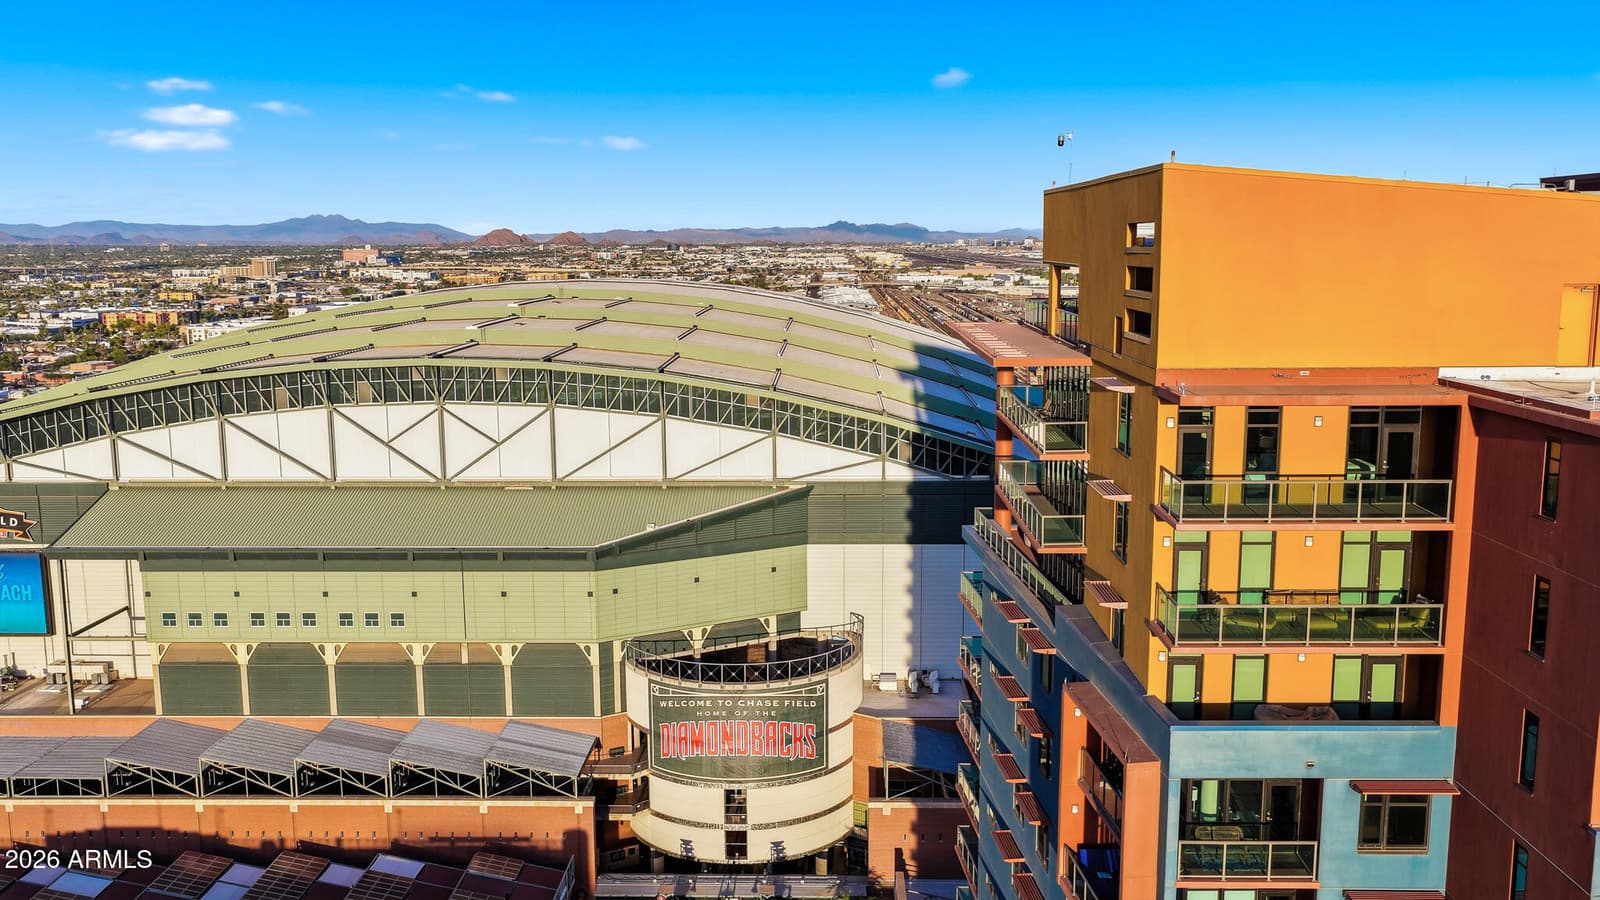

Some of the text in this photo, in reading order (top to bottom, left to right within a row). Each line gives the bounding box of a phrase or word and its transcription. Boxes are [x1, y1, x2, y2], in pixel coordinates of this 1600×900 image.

[660, 700, 712, 708] WELCOME
[718, 699, 733, 707] TO
[784, 700, 817, 708] FIELD
[659, 720, 816, 761] DIAMONDBACKS
